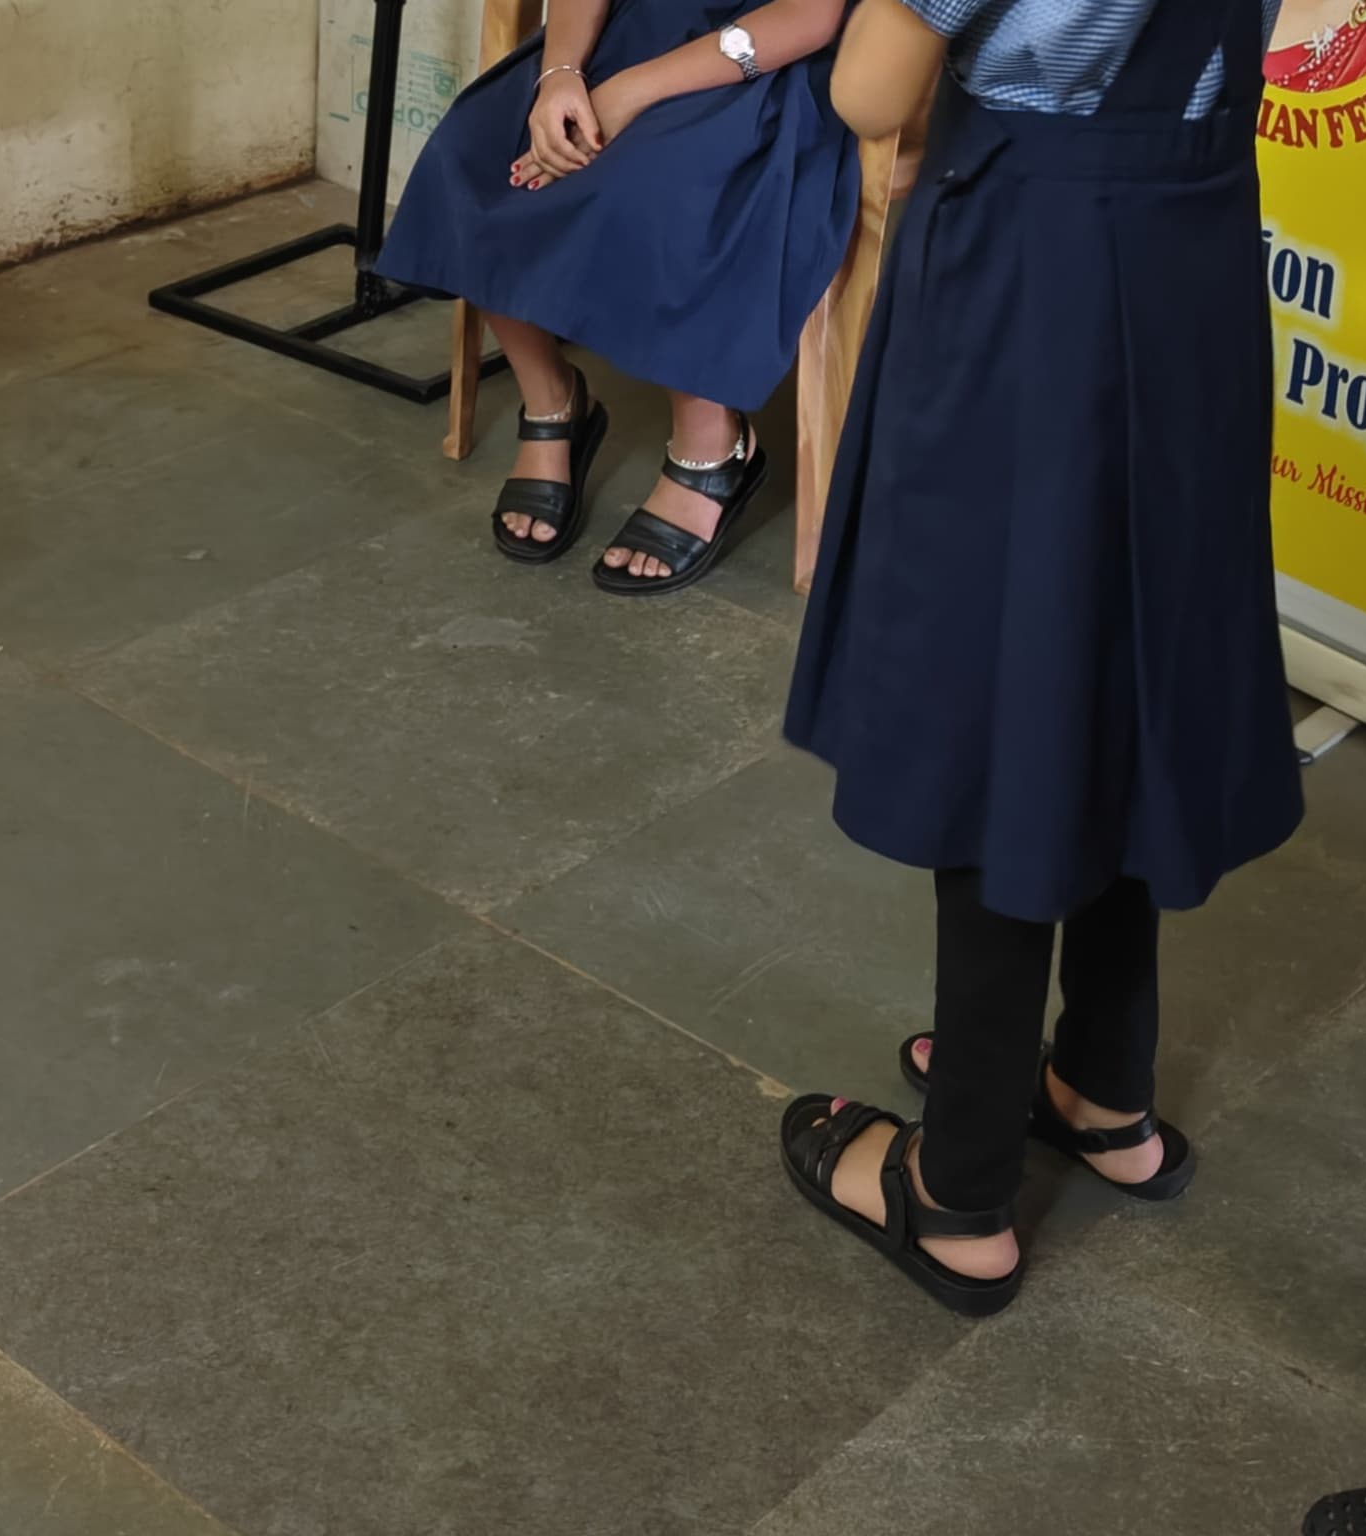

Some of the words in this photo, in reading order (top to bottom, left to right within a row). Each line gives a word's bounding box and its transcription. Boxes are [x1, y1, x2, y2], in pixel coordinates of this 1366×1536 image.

[1256, 98, 1320, 149] IAN
[1260, 229, 1335, 320] ion
[1271, 455, 1303, 483] ur
